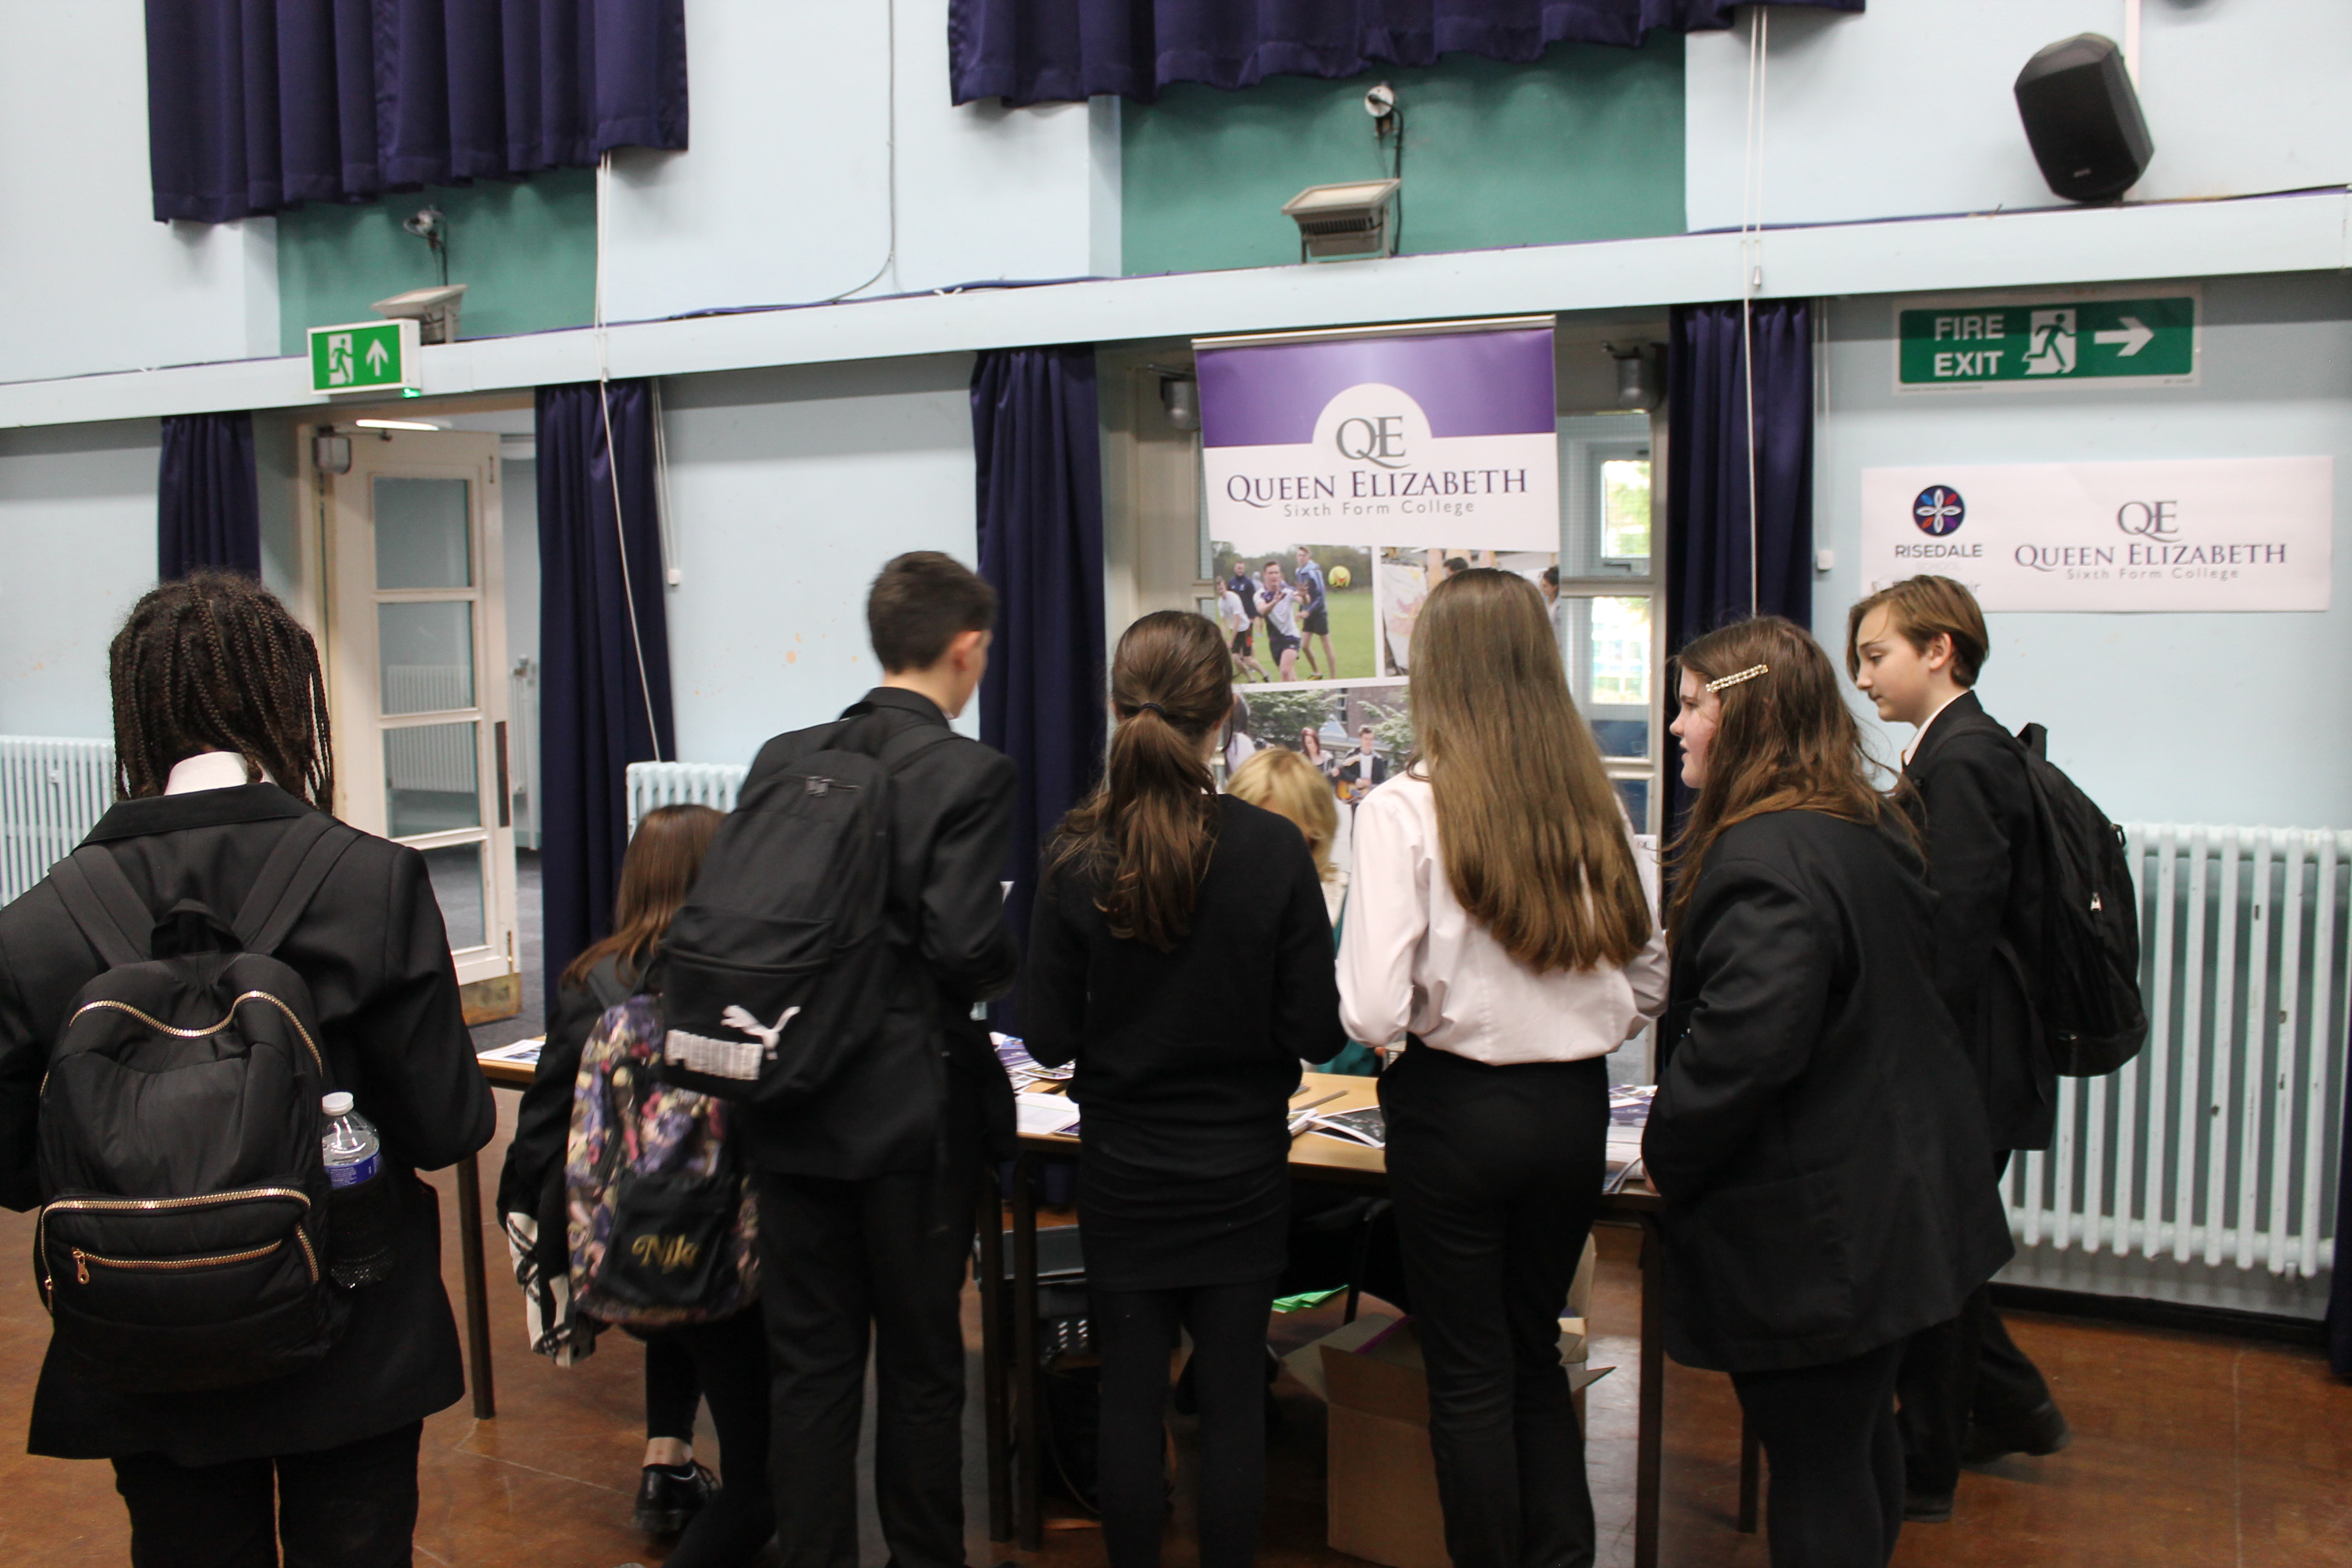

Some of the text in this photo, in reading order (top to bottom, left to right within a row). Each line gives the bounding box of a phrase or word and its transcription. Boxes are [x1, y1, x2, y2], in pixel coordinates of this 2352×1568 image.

[1935, 315, 2005, 341] FIRE
[1934, 350, 2005, 377] EXIT
[1336, 416, 1412, 469] QE
[1227, 469, 1527, 508] QUEEN ELIZABETH
[1284, 499, 1474, 517] Sixth Form College
[2117, 500, 2182, 543] QE
[1895, 545, 1983, 558] RISEDALE
[2015, 543, 2286, 573] QUEEN ELIZABETH
[2067, 568, 2239, 581] Sixth Form College
